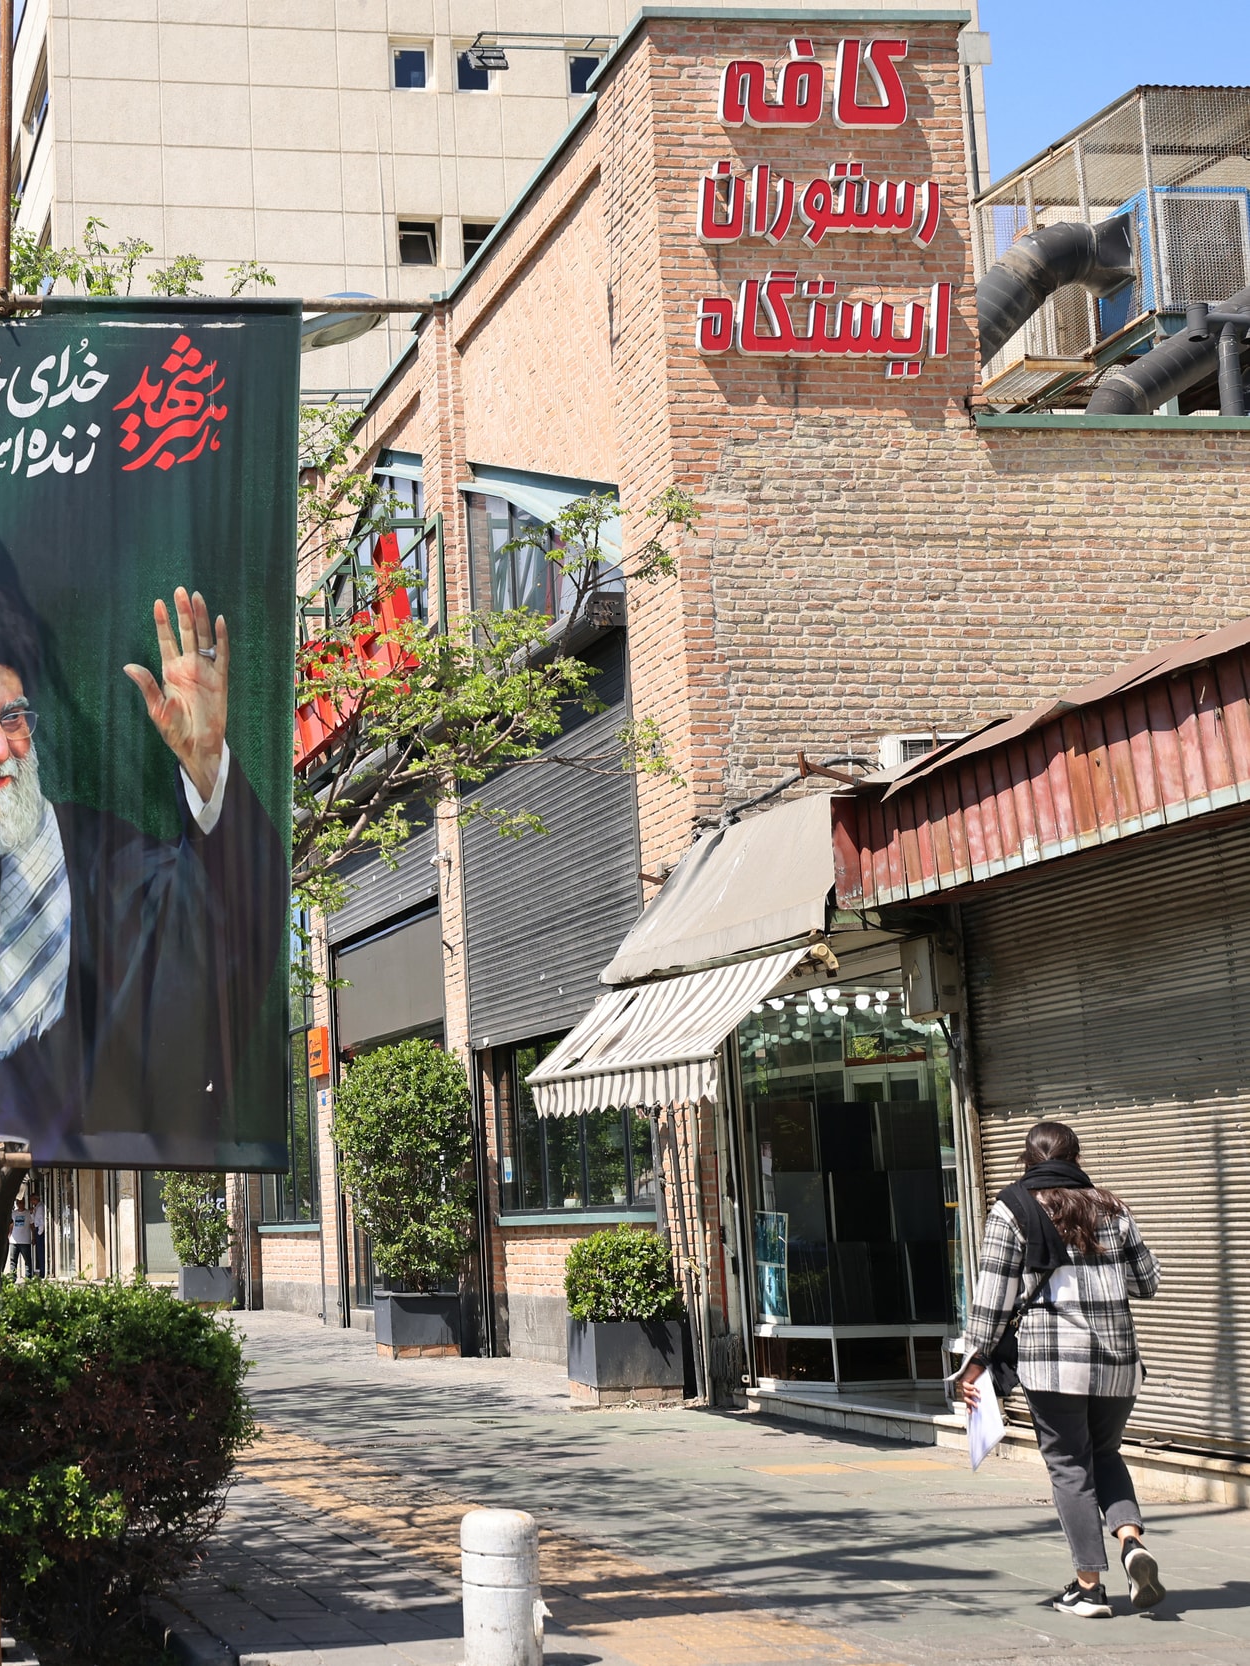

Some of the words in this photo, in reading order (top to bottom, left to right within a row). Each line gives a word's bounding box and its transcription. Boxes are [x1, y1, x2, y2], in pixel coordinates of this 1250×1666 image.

[717, 38, 909, 129] کافه
[696, 160, 941, 249] رستوران
[695, 270, 952, 379] ایستگاه
[112, 334, 227, 452] شهید
[27, 421, 101, 478] زنده
